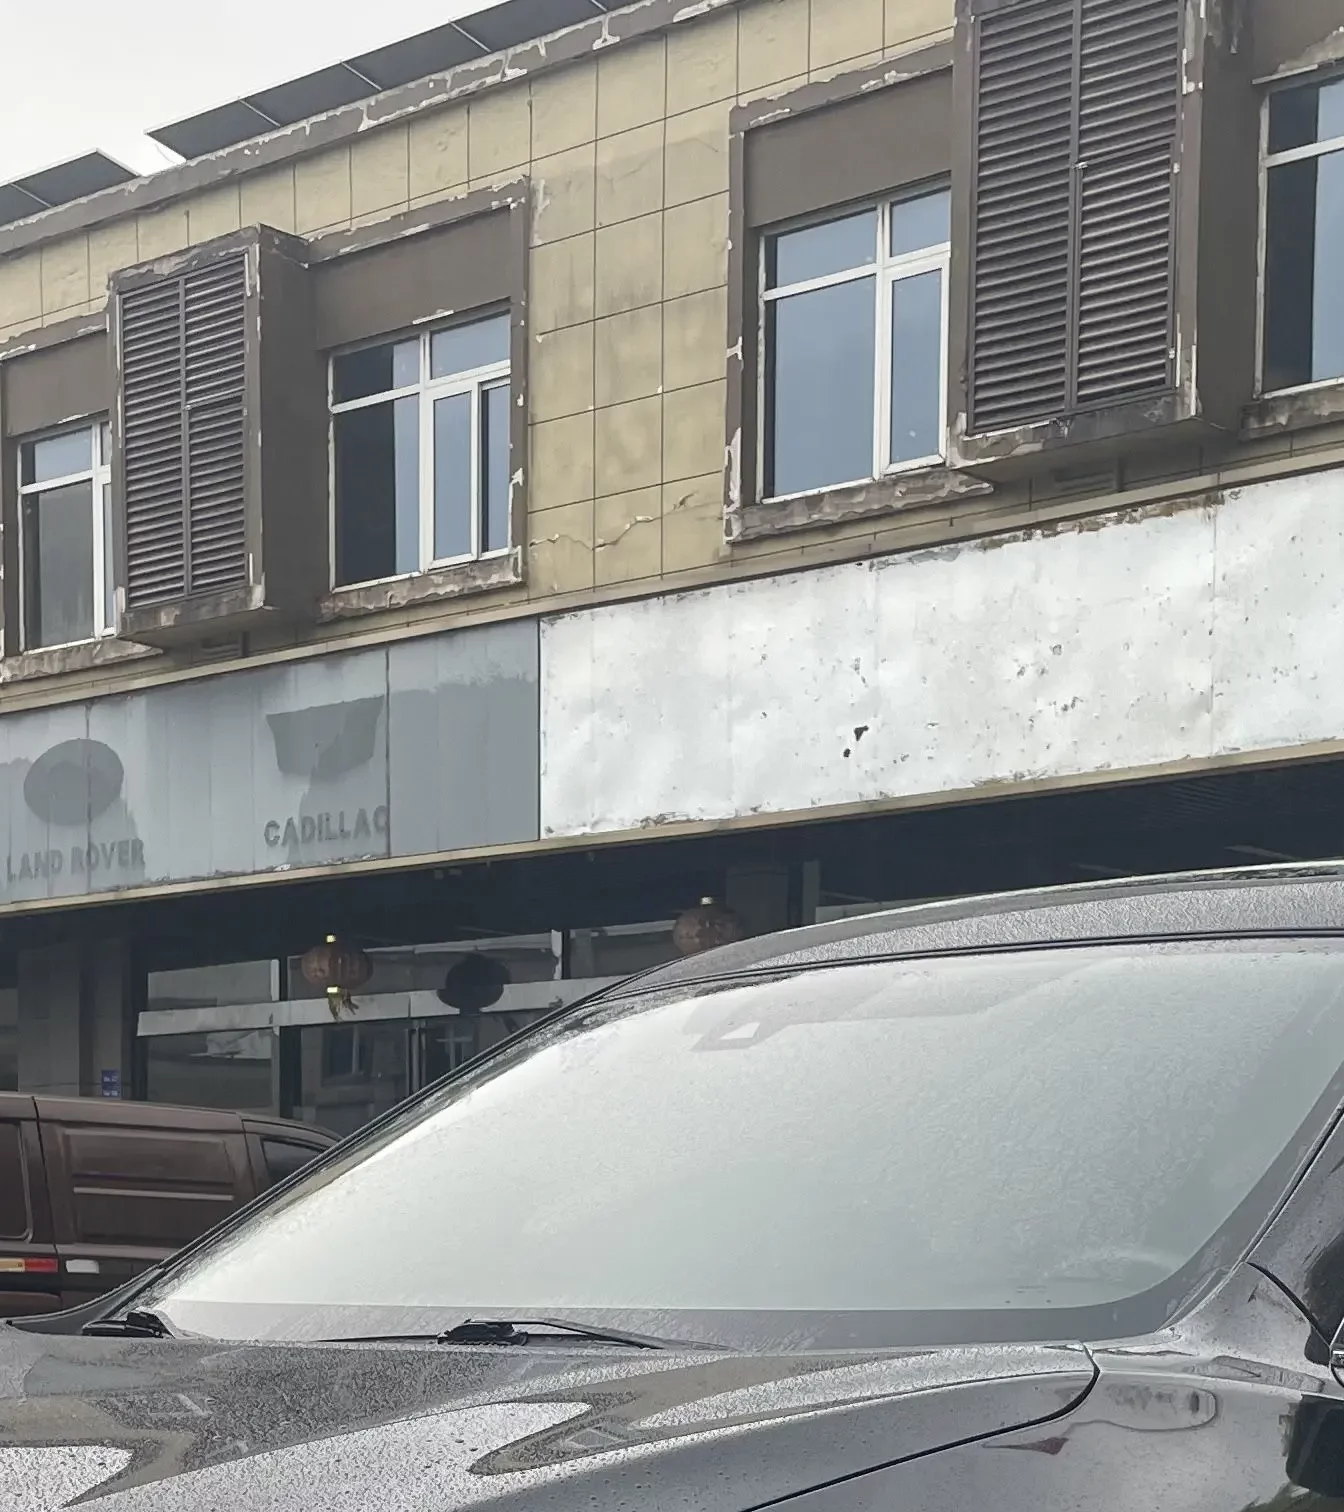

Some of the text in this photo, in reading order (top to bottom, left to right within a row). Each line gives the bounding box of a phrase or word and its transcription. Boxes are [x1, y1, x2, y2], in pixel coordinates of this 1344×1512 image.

[264, 805, 388, 847] CADILLAC
[7, 838, 145, 883] LAND ROVER
